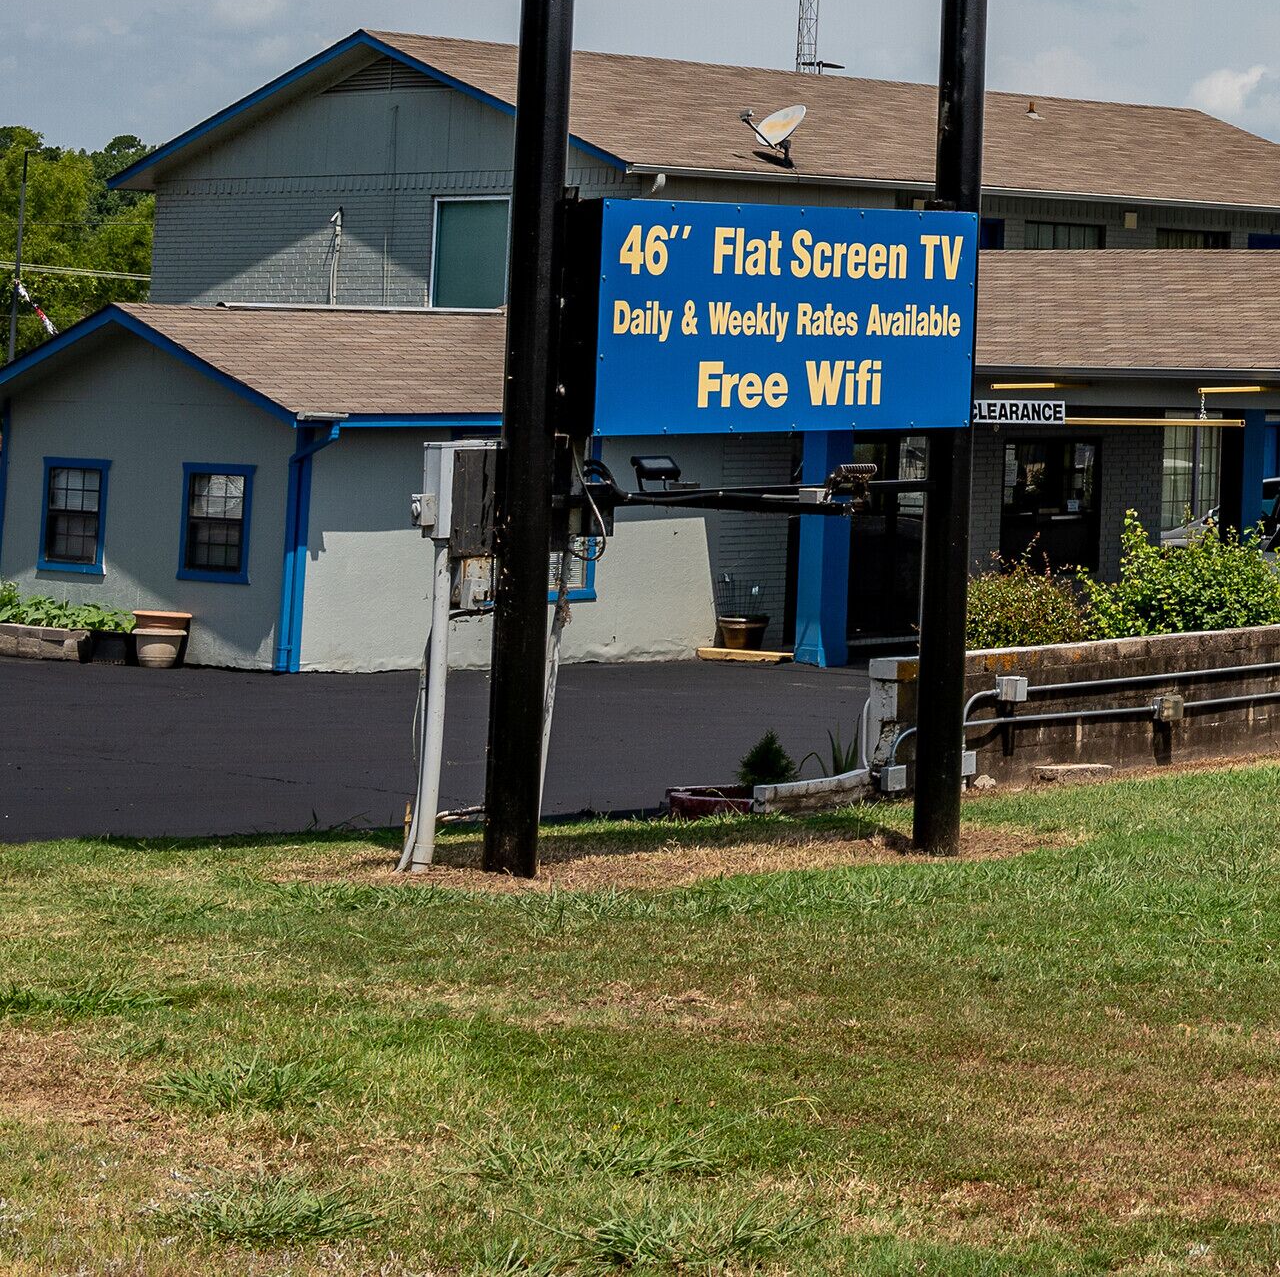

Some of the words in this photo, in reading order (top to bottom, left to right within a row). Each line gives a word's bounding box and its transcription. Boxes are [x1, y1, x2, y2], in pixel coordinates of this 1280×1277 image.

[712, 225, 783, 276] Flat
[789, 228, 908, 280] Screen
[919, 234, 964, 281] TV
[612, 299, 673, 343] Daily
[680, 299, 699, 336] &
[707, 301, 789, 343] Weekly
[796, 302, 859, 337] Rates
[865, 303, 961, 338] Available
[696, 360, 789, 409] Free
[805, 359, 882, 407] Wifi
